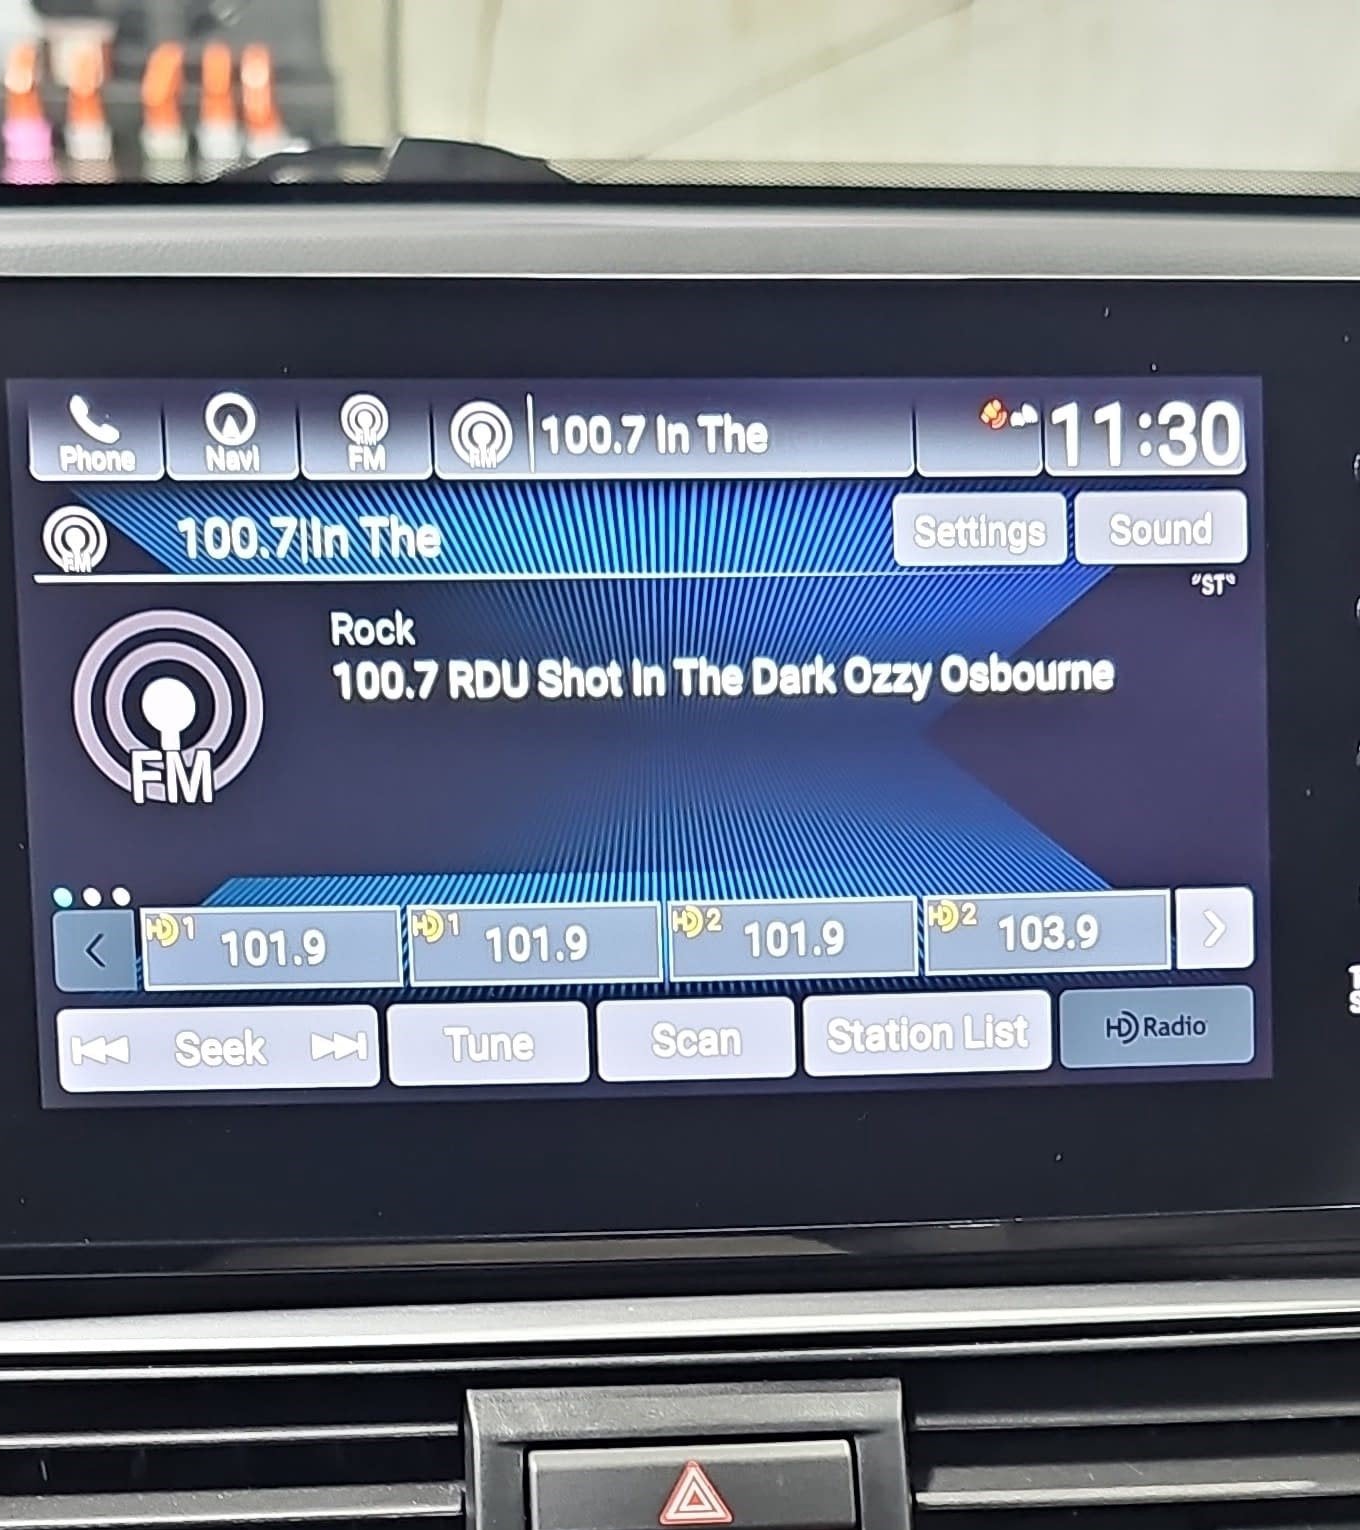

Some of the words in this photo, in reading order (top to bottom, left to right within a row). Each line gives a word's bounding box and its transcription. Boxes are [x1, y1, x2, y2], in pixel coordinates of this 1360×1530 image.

[541, 414, 644, 456] 100.7
[656, 414, 690, 454] In
[698, 413, 769, 454] The
[1051, 400, 1241, 468] 11:30
[59, 444, 136, 472] Phone
[206, 445, 260, 471] Navi
[348, 444, 387, 471] FM
[360, 515, 442, 559] The
[913, 514, 1047, 555] Settings
[1109, 511, 1213, 546] Sound
[330, 610, 416, 646] Rock
[332, 659, 437, 701] 100.7
[450, 659, 528, 698] RDU
[537, 657, 622, 698] Shot
[632, 658, 665, 697] In
[673, 656, 743, 696] The
[752, 654, 836, 695] Dark
[844, 655, 932, 702] Ozzy
[940, 652, 1114, 693] Osbourne
[130, 748, 214, 804] FM
[221, 929, 327, 969] 101.9
[483, 924, 589, 964] 101.9
[743, 920, 845, 958] 101.9
[998, 914, 1098, 952] 103.9
[443, 1025, 534, 1062] Tune
[651, 1021, 742, 1058] Scan
[827, 1017, 954, 1055] Station
[963, 1014, 1029, 1050] List
[1143, 1014, 1207, 1037] Radio
[174, 1029, 268, 1068] Seek
